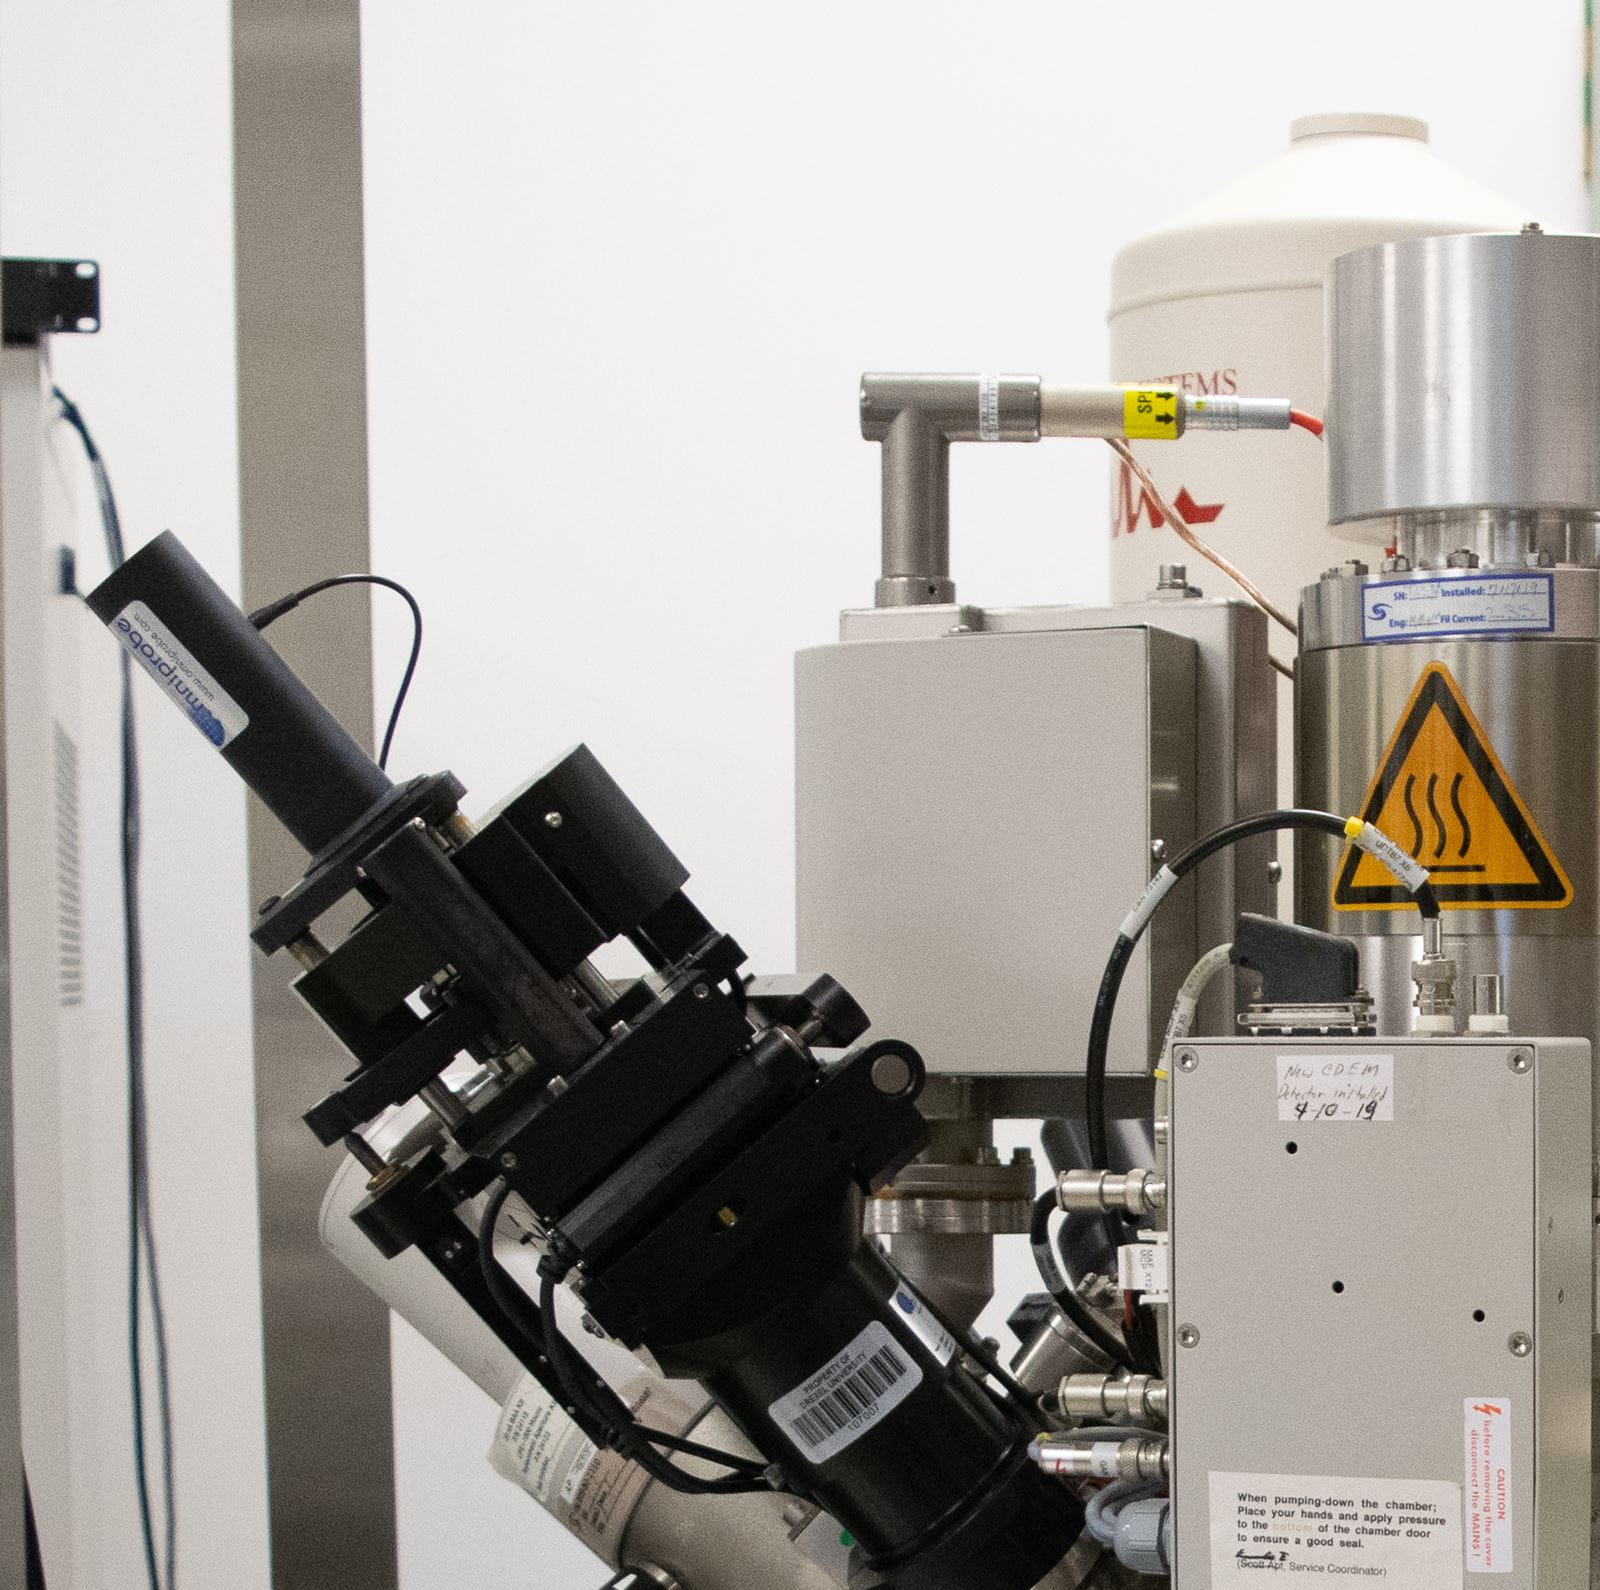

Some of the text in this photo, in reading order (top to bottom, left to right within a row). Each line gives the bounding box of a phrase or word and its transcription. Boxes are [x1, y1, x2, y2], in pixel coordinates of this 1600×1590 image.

[1441, 587, 1486, 598] Installed:
[1452, 613, 1487, 624] Current:
[1285, 1062, 1379, 1080] New CDEM
[803, 1362, 840, 1394] PROPERTY
[828, 1352, 868, 1388] UNIVERSITY
[1471, 1429, 1480, 1488] disconnect
[1237, 1492, 1437, 1513] When pumping-down the chamber;
[1471, 1491, 1480, 1509] the
[1482, 1420, 1493, 1567] before removing the cover
[1497, 1468, 1506, 1520] CAUTION
[1237, 1506, 1446, 1527] Place your hands and apply pressure
[1237, 1520, 1431, 1539] to the bottom of the chamber door
[1472, 1513, 1481, 1550] MAINS
[1237, 1533, 1247, 1543] to
[1253, 1536, 1289, 1545] ensure
[1306, 1537, 1333, 1549] good
[1339, 1539, 1365, 1549] seal.
[1289, 1562, 1326, 1573] Service
[1327, 1564, 1387, 1577] Coordinator)
